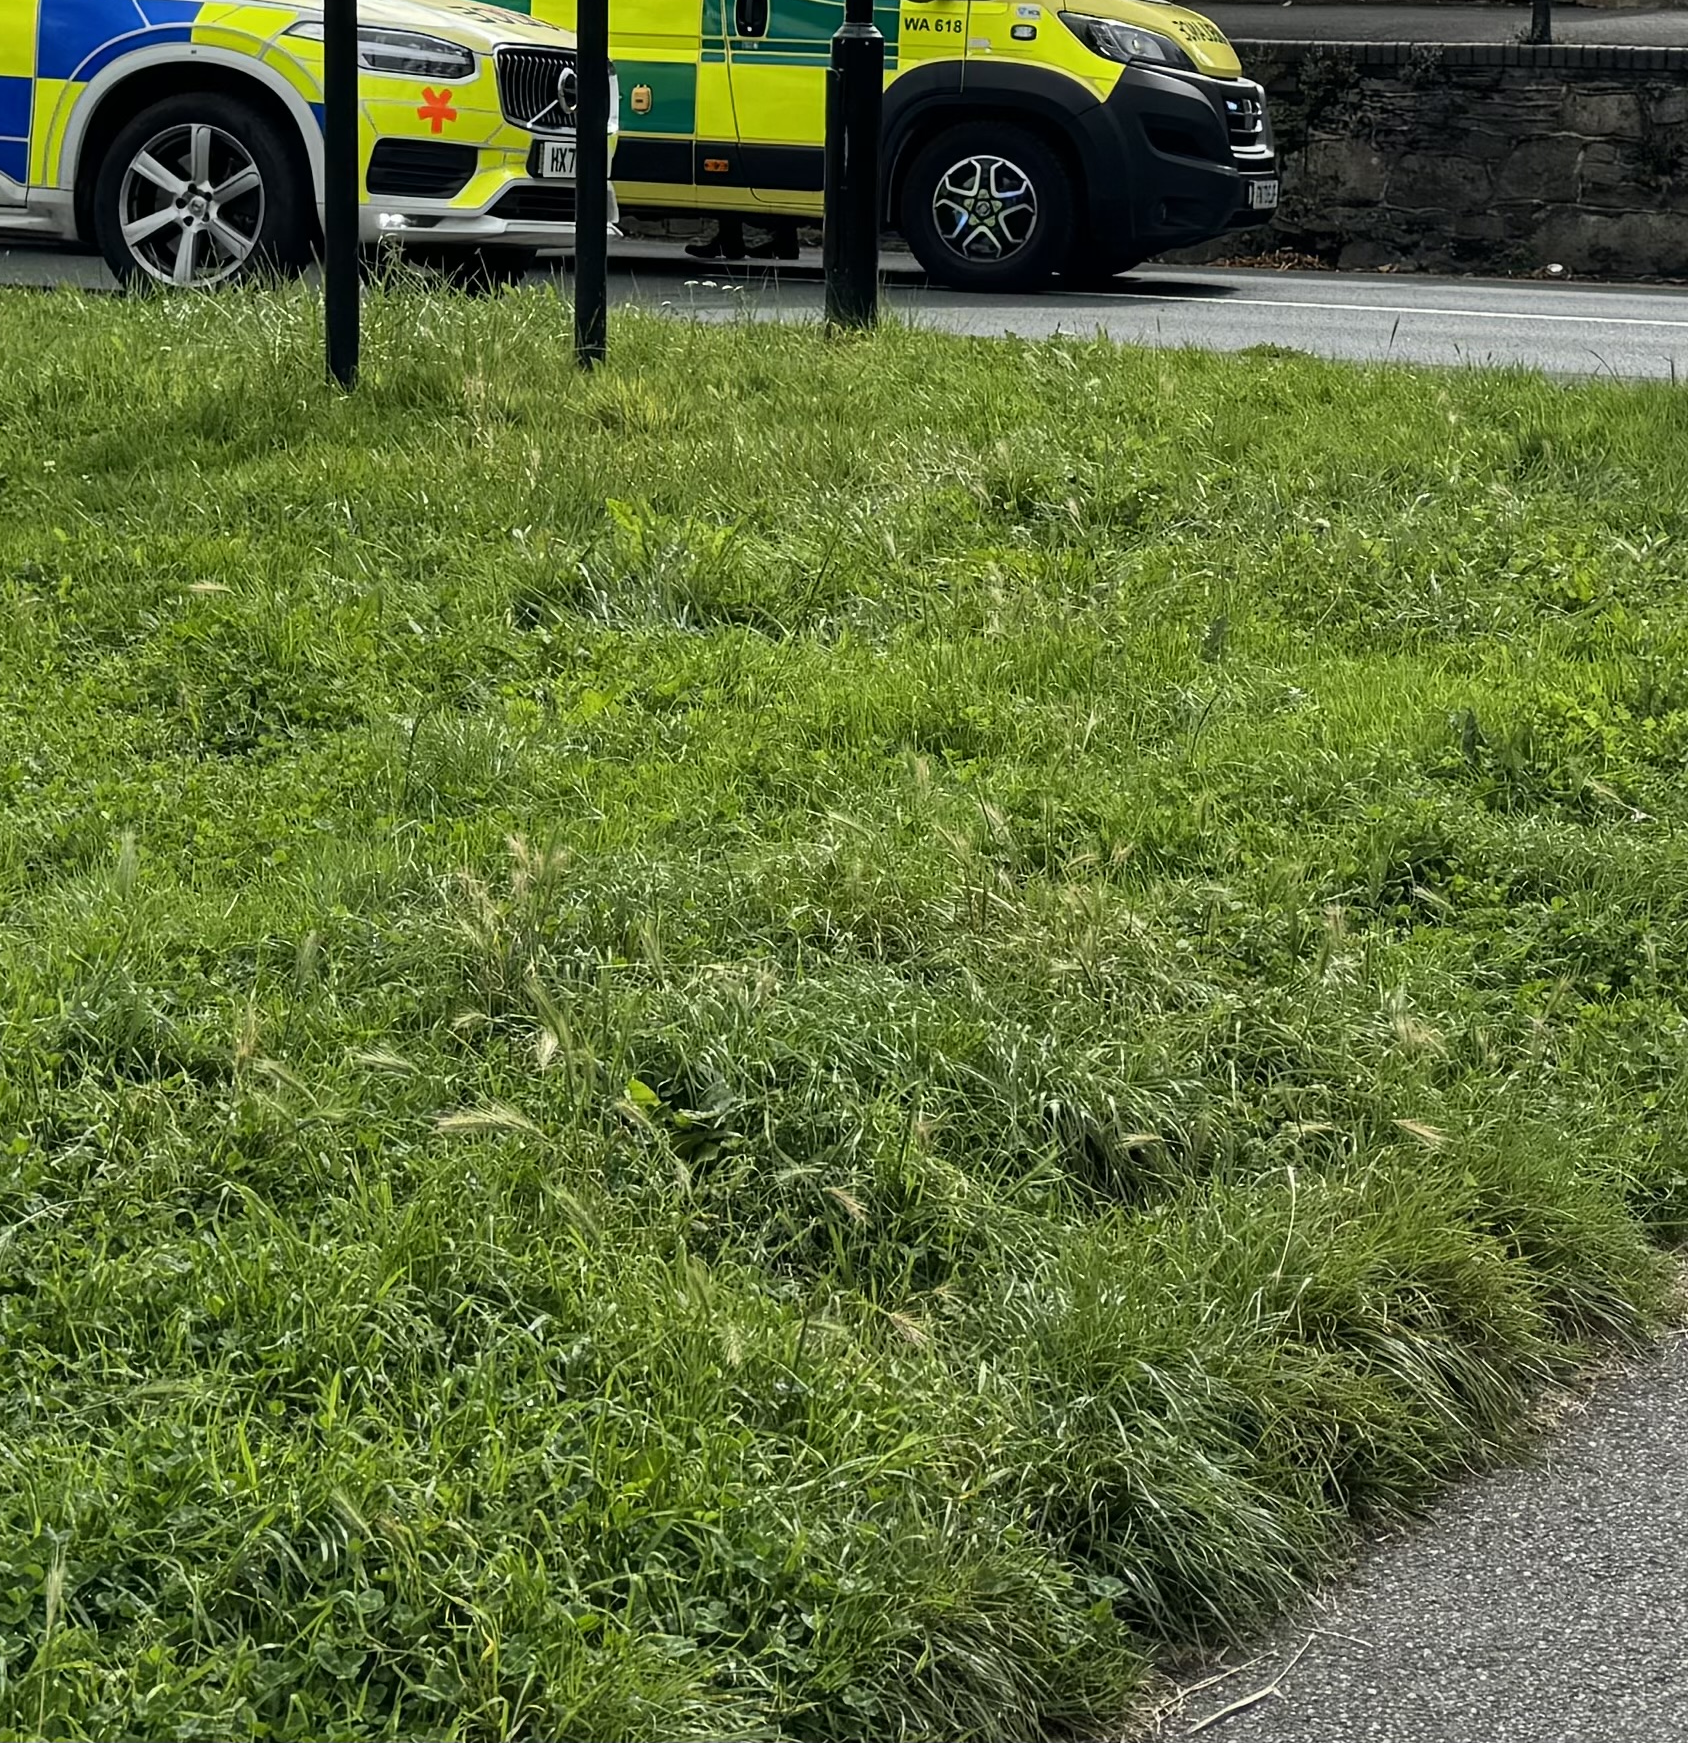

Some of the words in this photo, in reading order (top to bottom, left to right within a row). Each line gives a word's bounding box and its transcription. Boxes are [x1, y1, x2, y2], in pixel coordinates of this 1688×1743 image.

[904, 17, 930, 32] WA
[934, 19, 963, 34] 618
[550, 147, 577, 174] HX7
